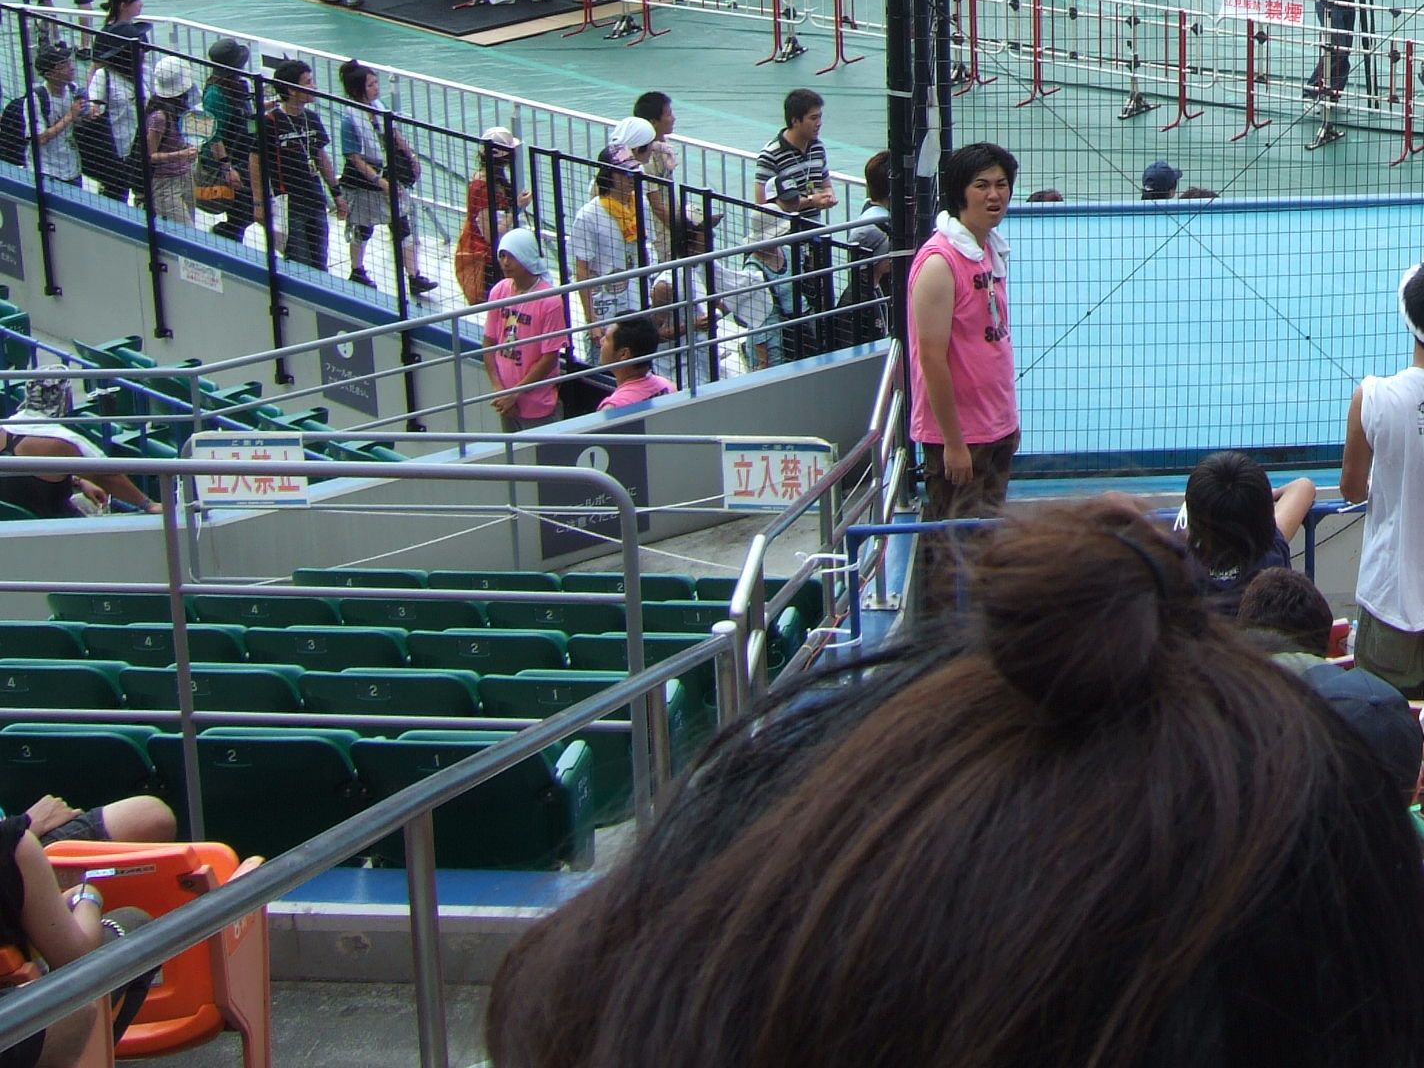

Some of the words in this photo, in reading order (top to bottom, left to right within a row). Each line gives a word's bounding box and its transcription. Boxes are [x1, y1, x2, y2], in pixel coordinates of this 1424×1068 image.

[1263, 0, 1303, 25] 禁煙
[733, 454, 824, 500] 立入禁止
